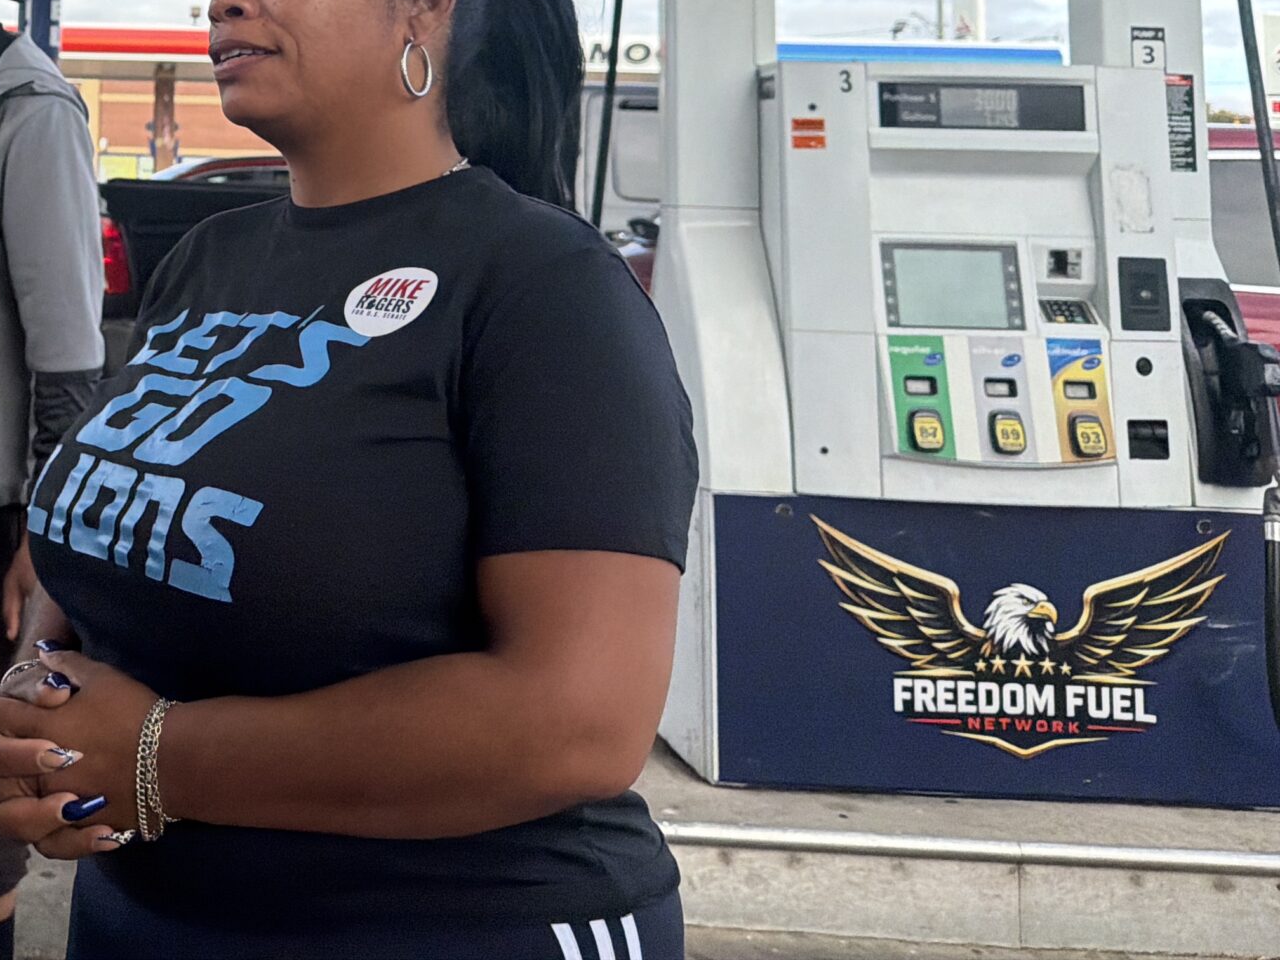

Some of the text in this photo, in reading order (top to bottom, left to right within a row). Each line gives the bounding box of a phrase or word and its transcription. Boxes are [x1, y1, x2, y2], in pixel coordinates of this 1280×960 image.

[1141, 45, 1155, 65] 3
[838, 70, 853, 93] 3
[364, 278, 432, 300] MIKE
[355, 295, 414, 314] ROGERS
[128, 305, 371, 388] LET'S
[76, 374, 273, 467] GO
[1001, 427, 1021, 441] 89
[1080, 431, 1102, 445] 93
[27, 443, 264, 603] LIONS
[893, 678, 1158, 725] FREEDOM FUEL
[967, 717, 1080, 733] NETWORK
